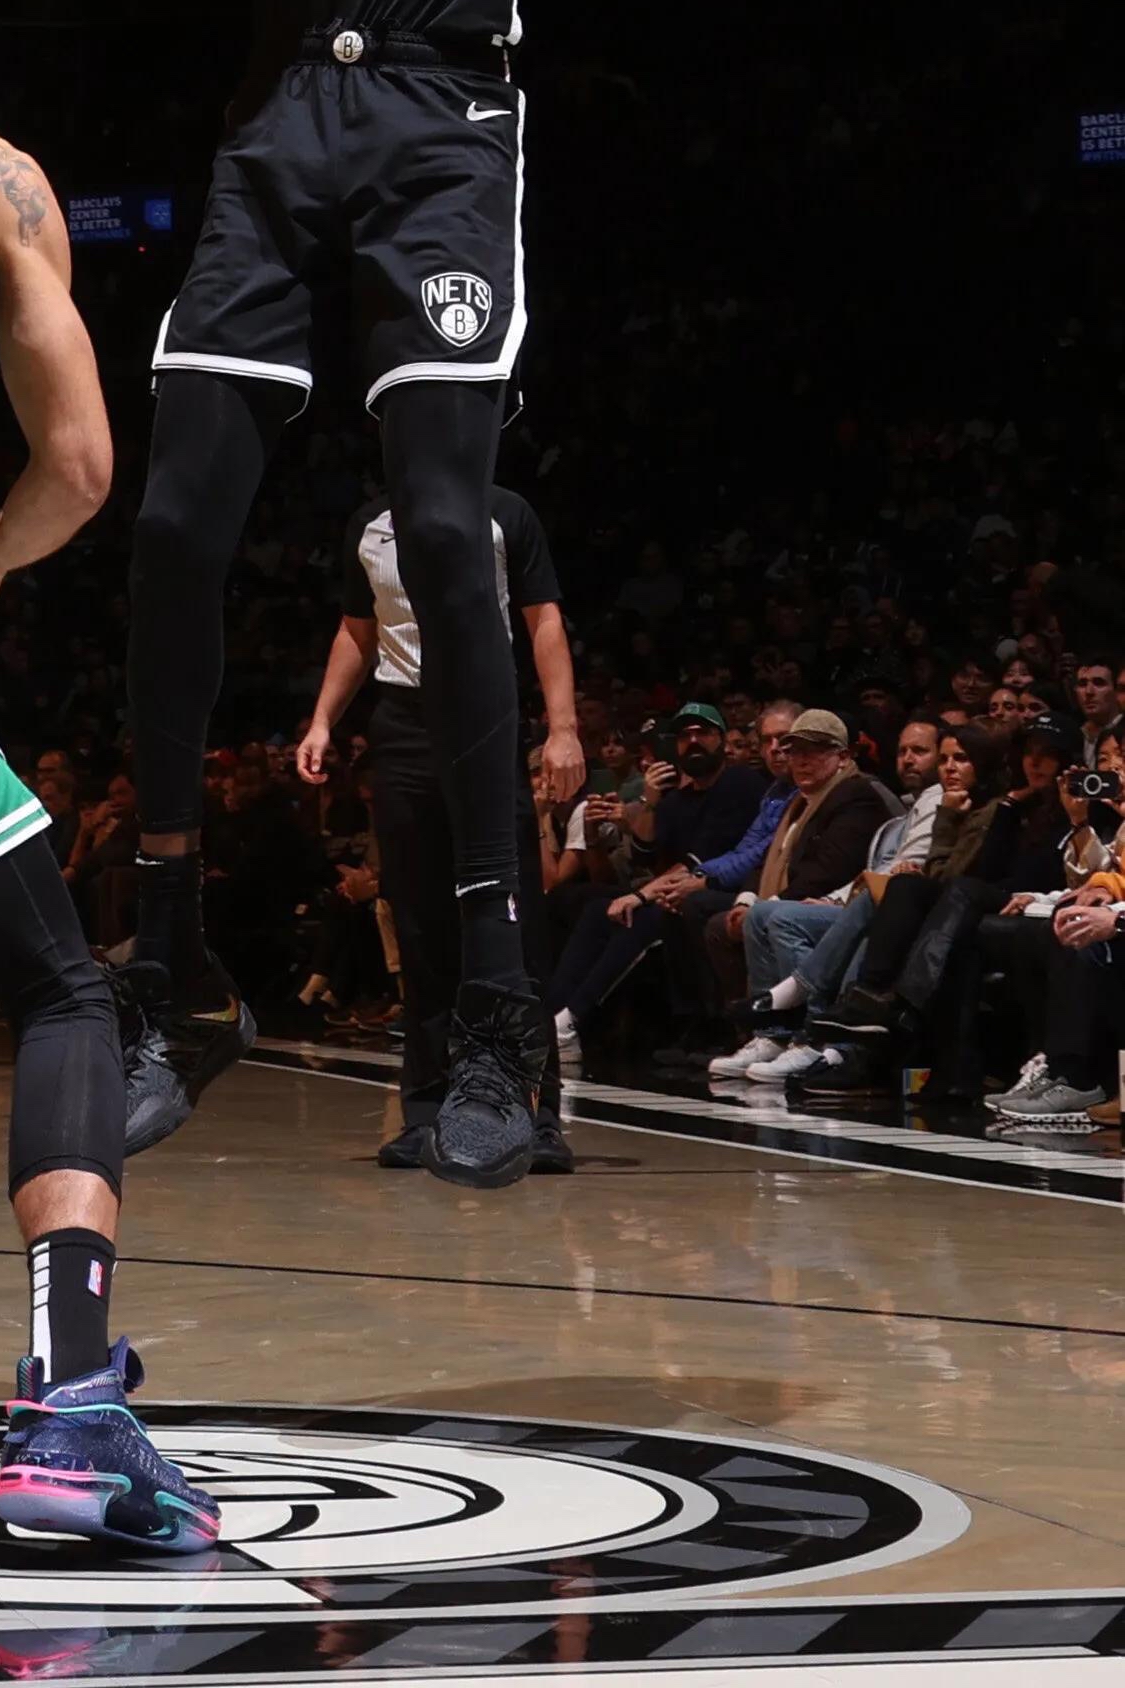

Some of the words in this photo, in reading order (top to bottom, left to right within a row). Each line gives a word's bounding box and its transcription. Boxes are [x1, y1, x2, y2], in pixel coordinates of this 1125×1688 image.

[69, 196, 122, 210] BARCLAYS
[69, 209, 110, 220] CENTER
[427, 277, 488, 311] NETS
[455, 310, 466, 334] B
